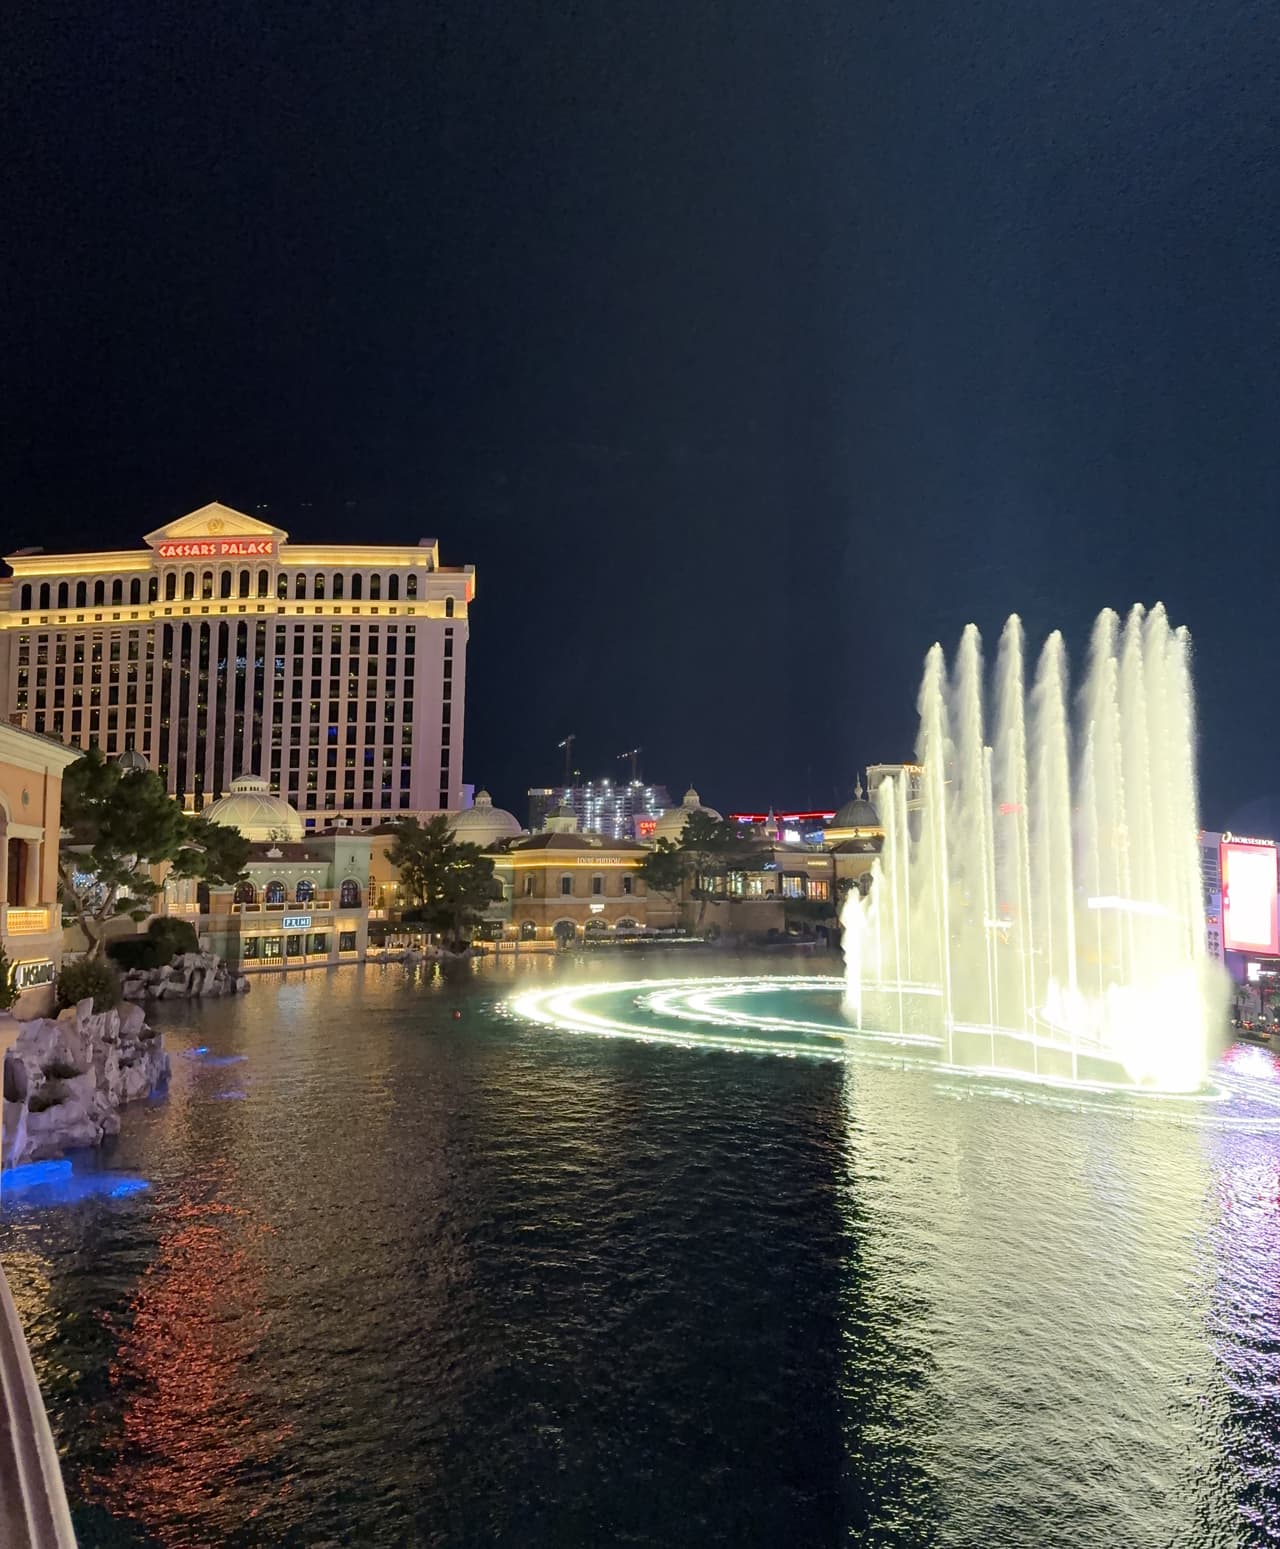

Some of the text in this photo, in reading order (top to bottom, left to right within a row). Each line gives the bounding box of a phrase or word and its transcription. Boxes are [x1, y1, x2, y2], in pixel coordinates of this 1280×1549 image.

[159, 542, 272, 557] CAESARS PALACE
[1232, 837, 1276, 846] HORSESHOE
